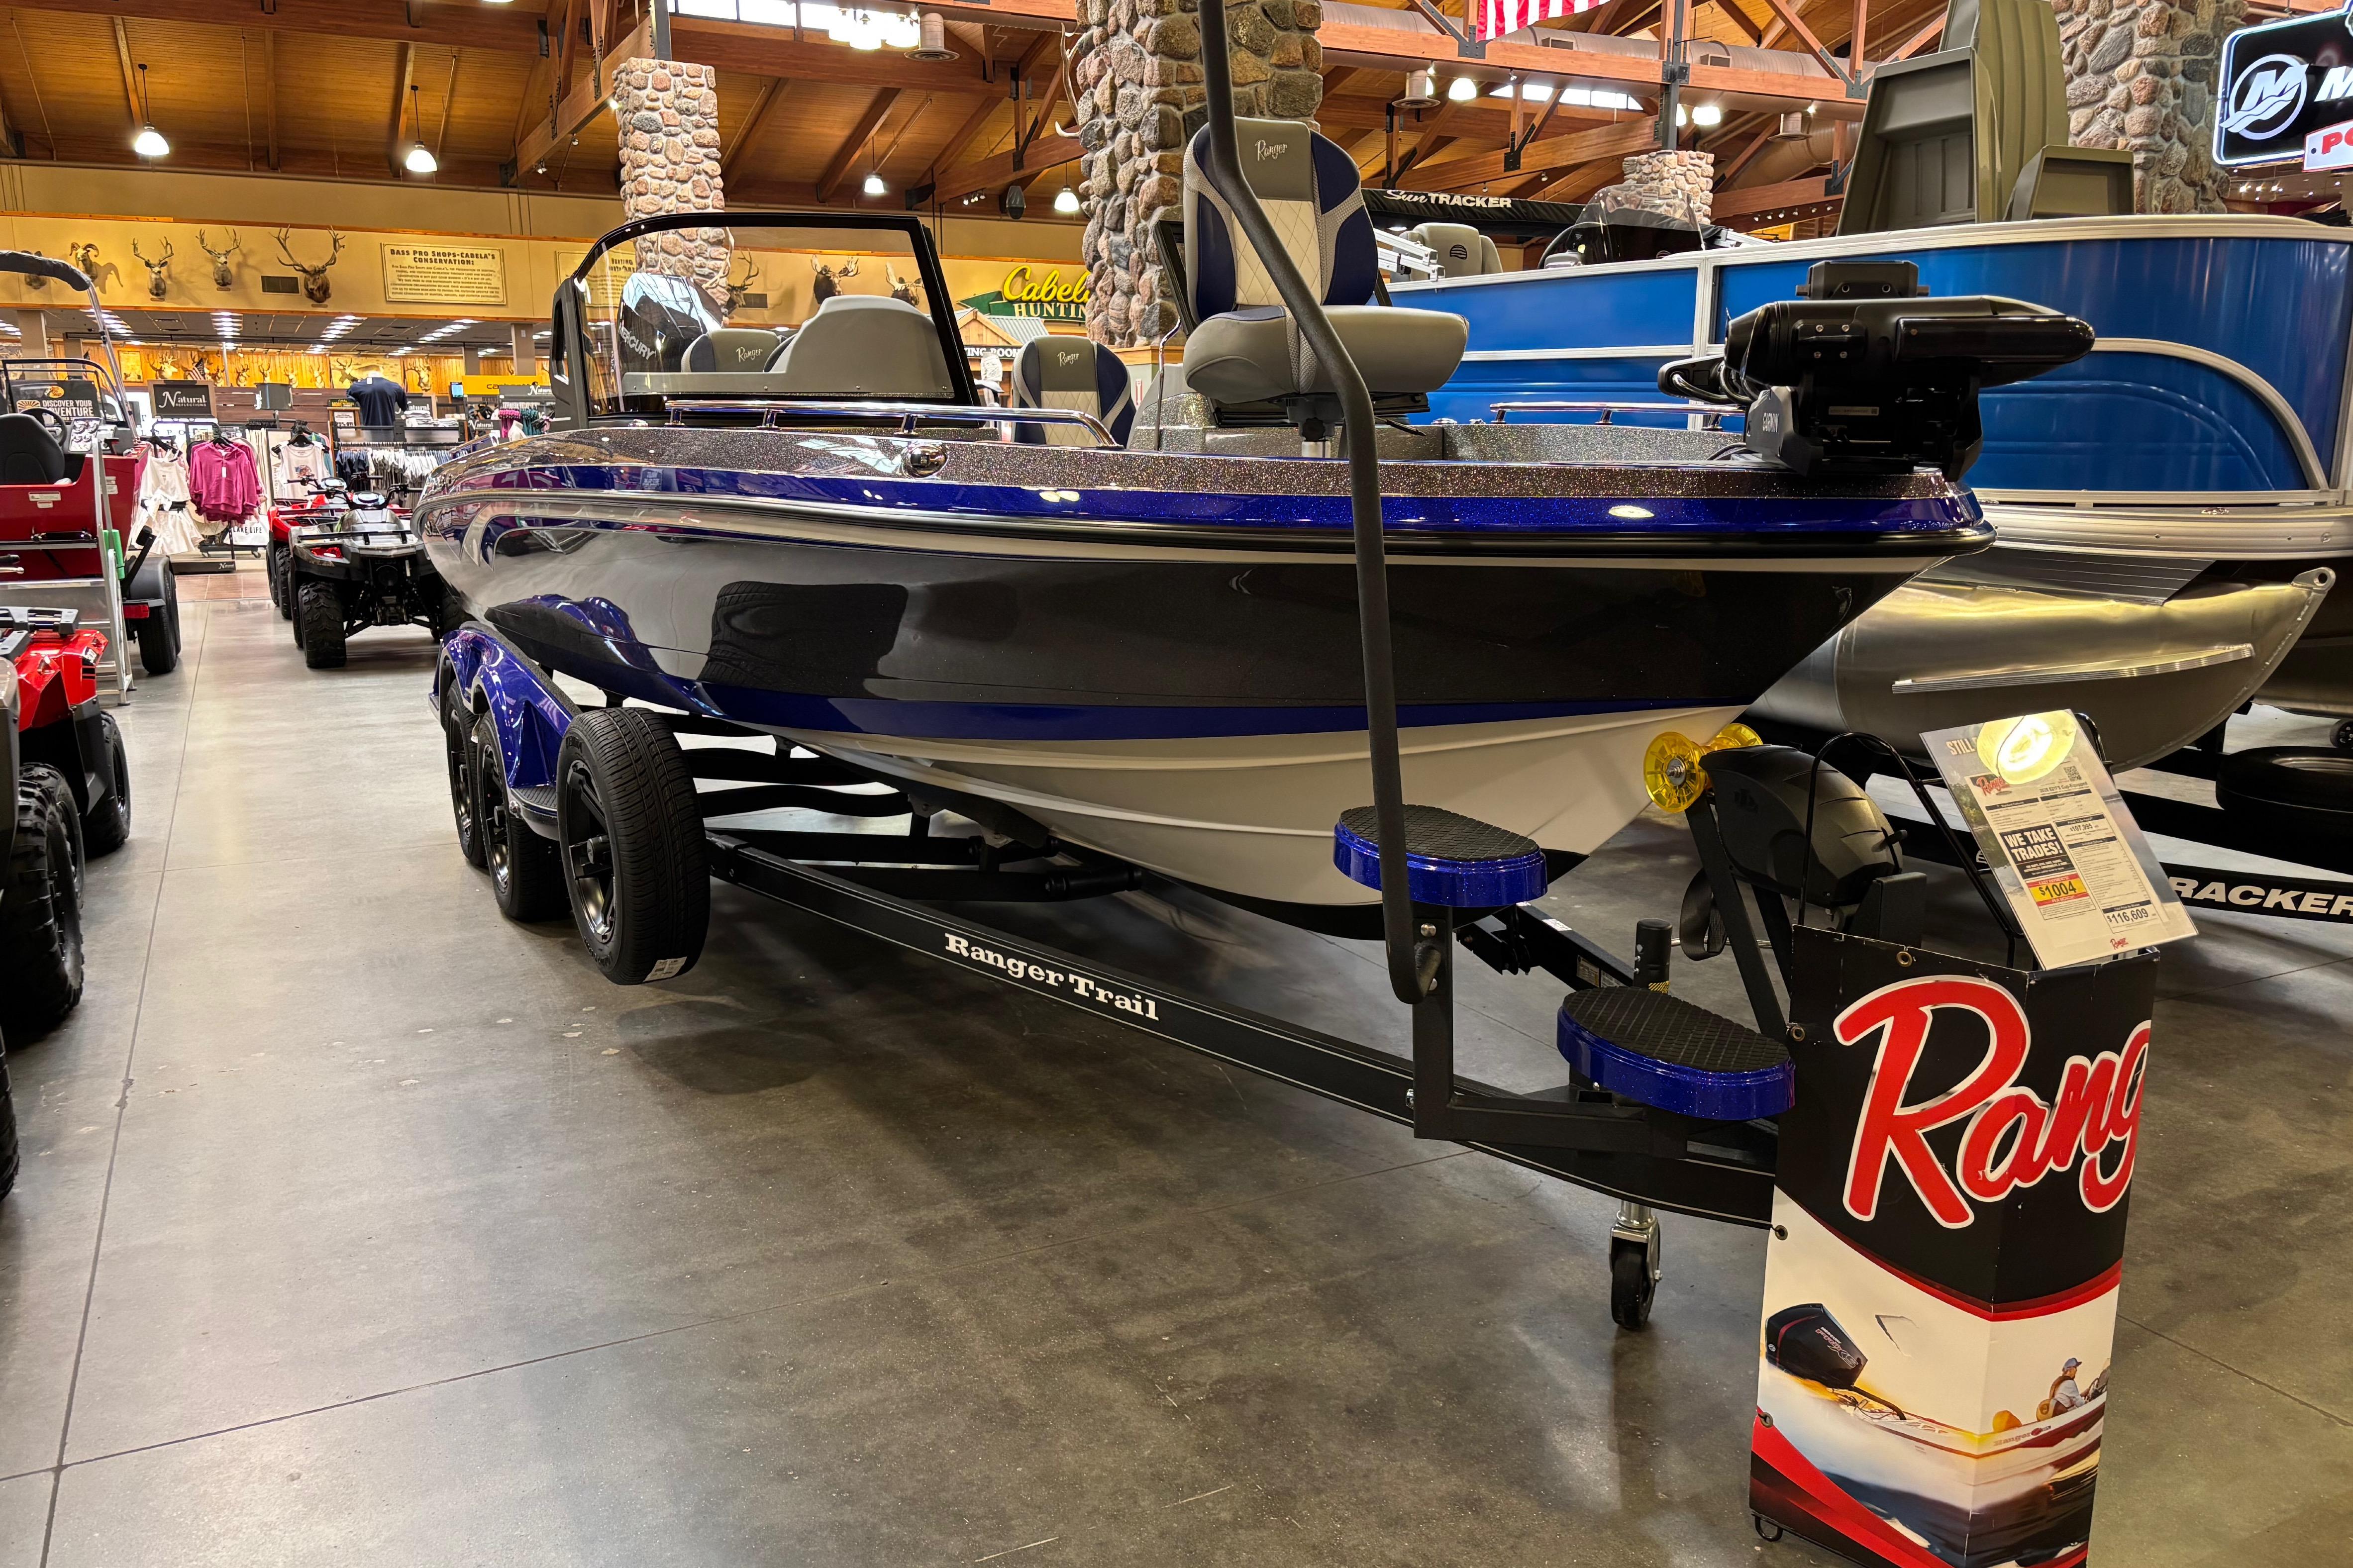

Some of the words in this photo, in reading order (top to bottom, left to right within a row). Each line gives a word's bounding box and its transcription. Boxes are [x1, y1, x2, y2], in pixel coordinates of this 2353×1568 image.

[1255, 139, 1288, 161] Ranger
[1428, 193, 1512, 208] TRACKER
[618, 324, 655, 360] MERCURY
[736, 347, 763, 363] Ranger
[1057, 352, 1080, 367] Ranger
[159, 391, 207, 408] Natural
[1762, 412, 1779, 433] GARMIN
[1946, 737, 1975, 755] STILL
[2004, 833, 2026, 848] WE
[2023, 828, 2056, 844] TAKE
[2011, 841, 2063, 862] TRADES!
[2039, 881, 2076, 897] $1004
[2107, 908, 2148, 924] $116,609
[945, 933, 1064, 986] Ranger
[1069, 973, 1159, 1021] Trail
